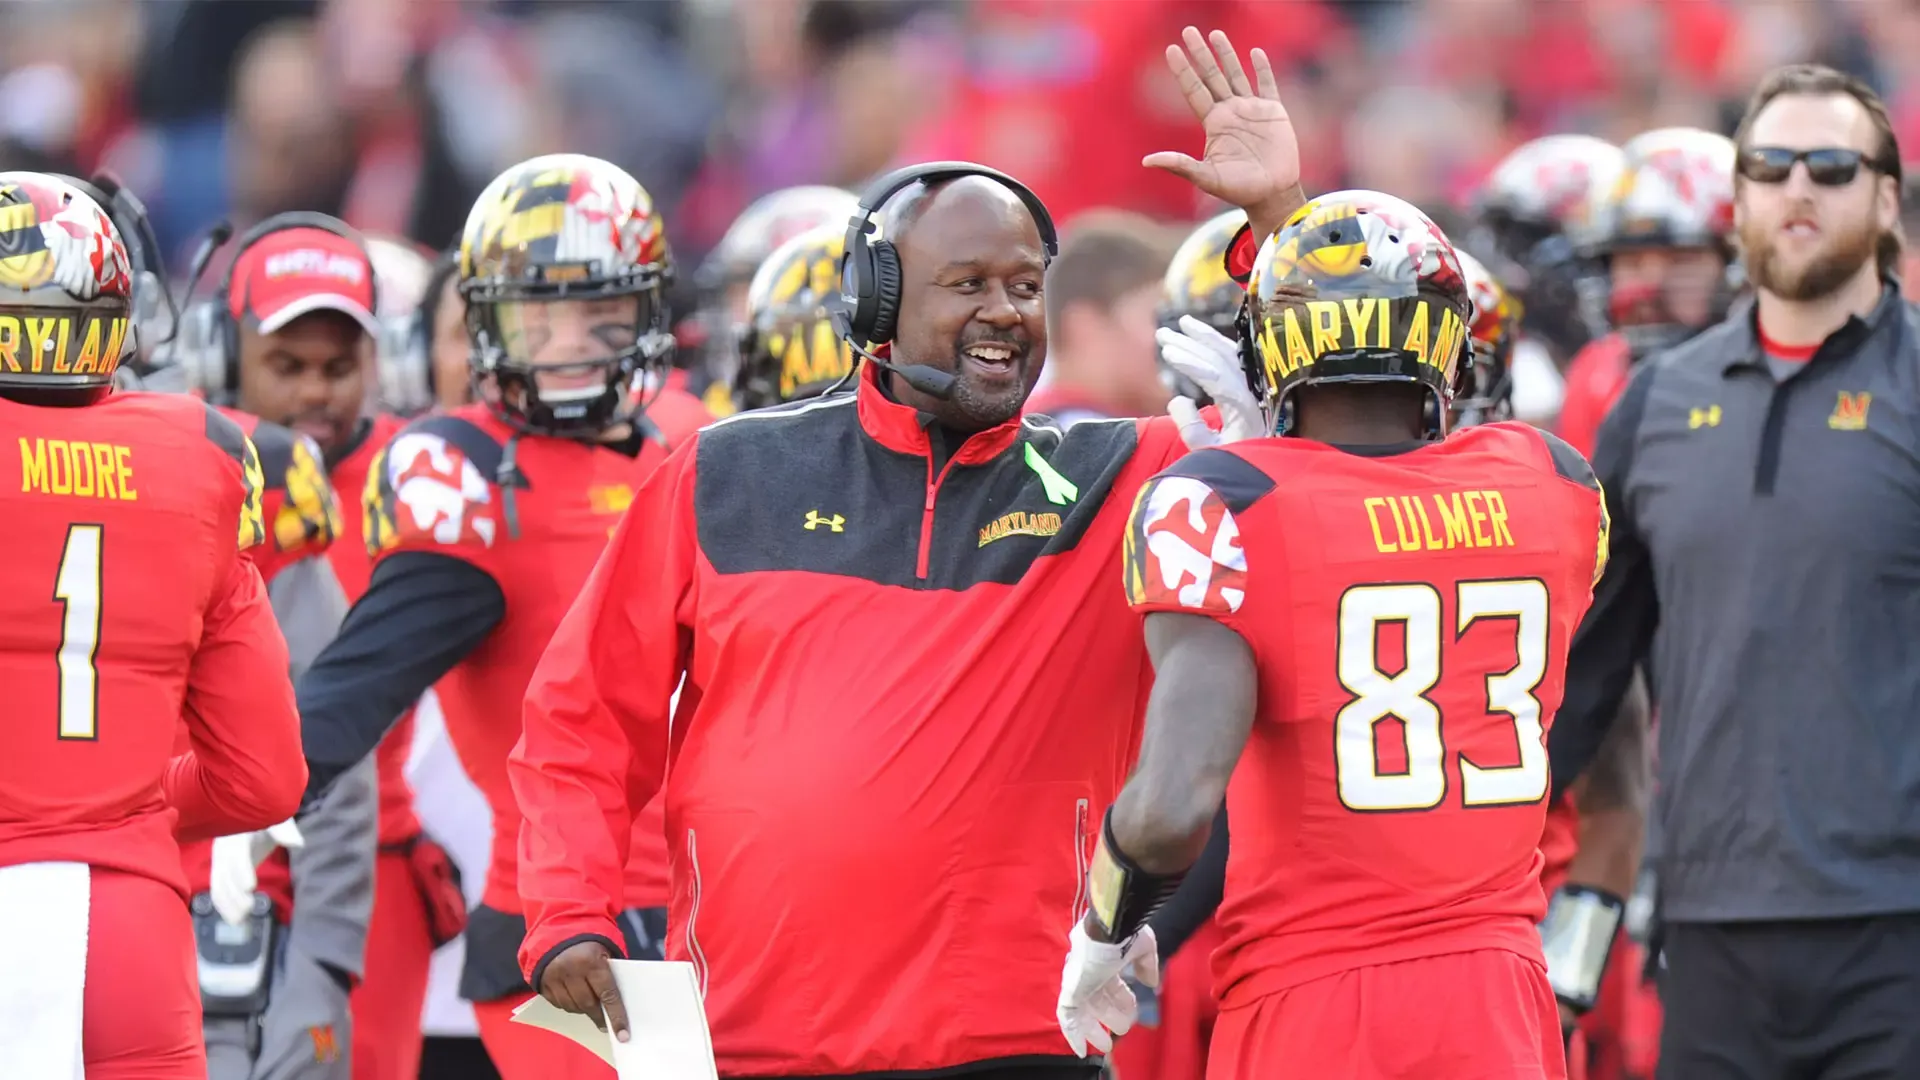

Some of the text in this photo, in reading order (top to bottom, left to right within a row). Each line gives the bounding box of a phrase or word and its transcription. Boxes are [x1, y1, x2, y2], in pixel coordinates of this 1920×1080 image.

[18, 437, 138, 501] MOORE
[978, 511, 1062, 548] MARYLAND
[1363, 490, 1515, 553] CULMER
[52, 522, 105, 742] 1
[1333, 576, 1551, 814] 83
